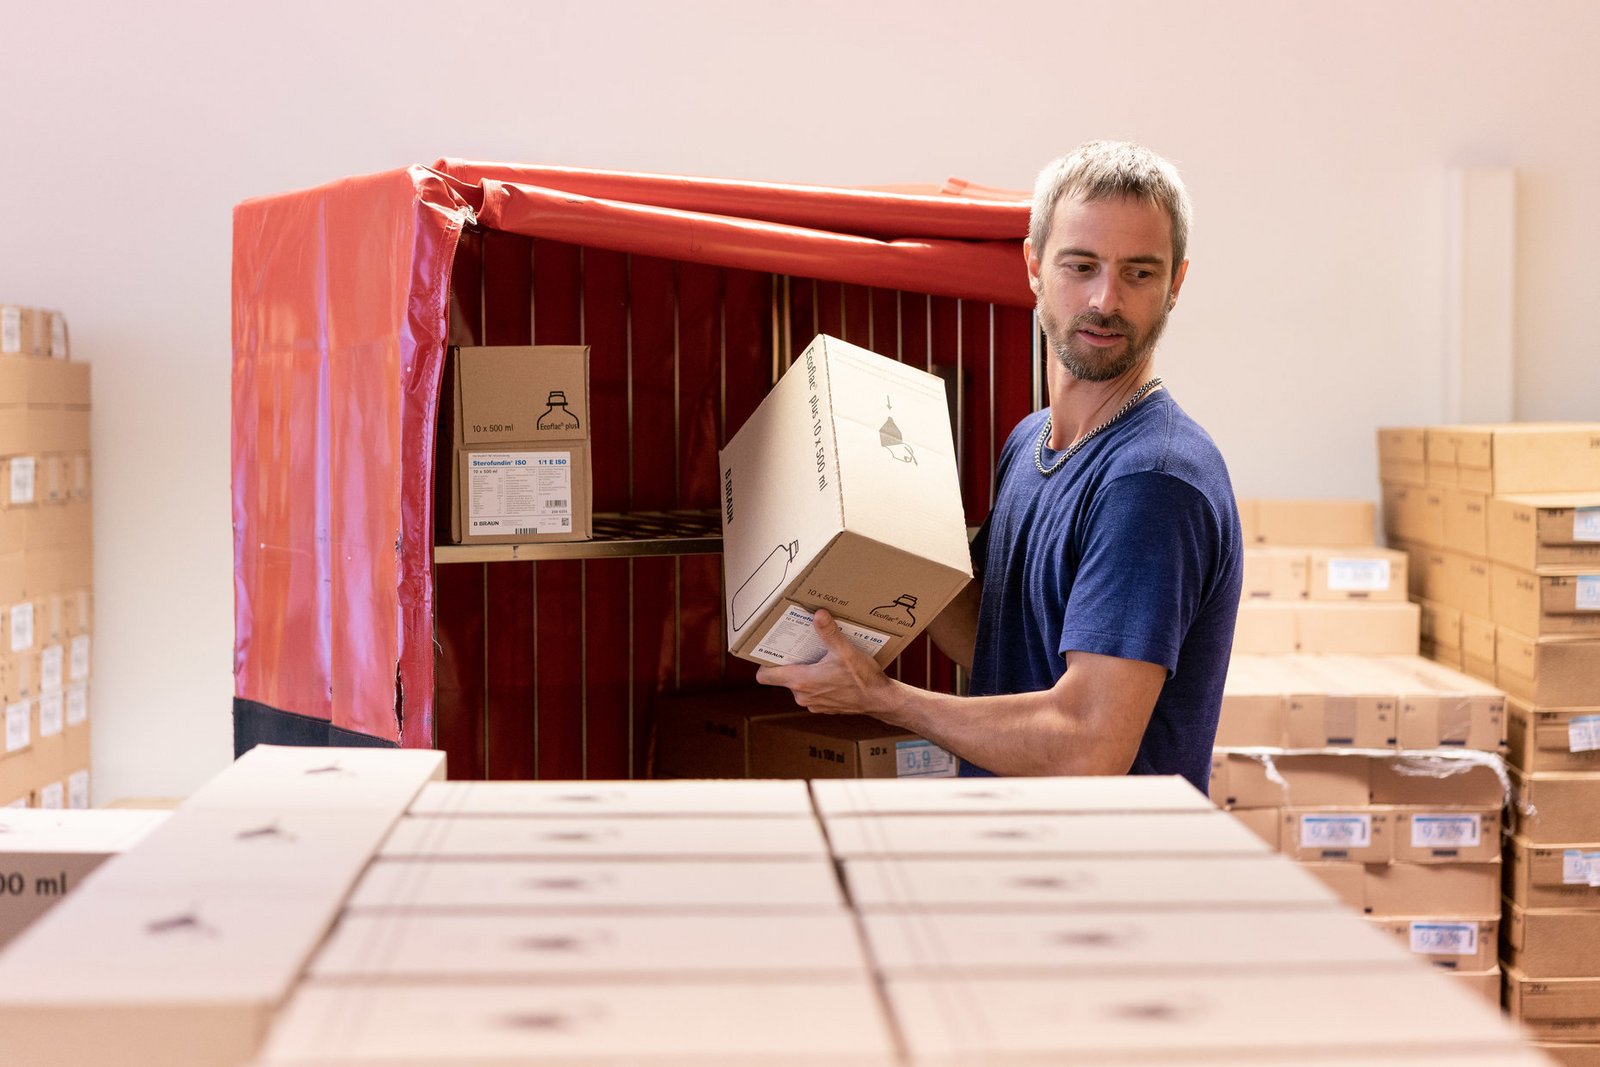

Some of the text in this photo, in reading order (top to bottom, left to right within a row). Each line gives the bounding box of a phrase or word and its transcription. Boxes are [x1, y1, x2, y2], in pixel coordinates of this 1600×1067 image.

[808, 395, 820, 420] plus
[472, 424, 481, 432] 10
[489, 424, 503, 432] 500
[504, 424, 514, 432] ml
[565, 422, 578, 431] plus
[814, 419, 822, 436] 10
[815, 438, 822, 448] x
[816, 446, 826, 473] 500
[818, 474, 828, 492] ml
[822, 594, 838, 604] 500
[870, 747, 880, 756] 20
[36, 870, 68, 896] ml
